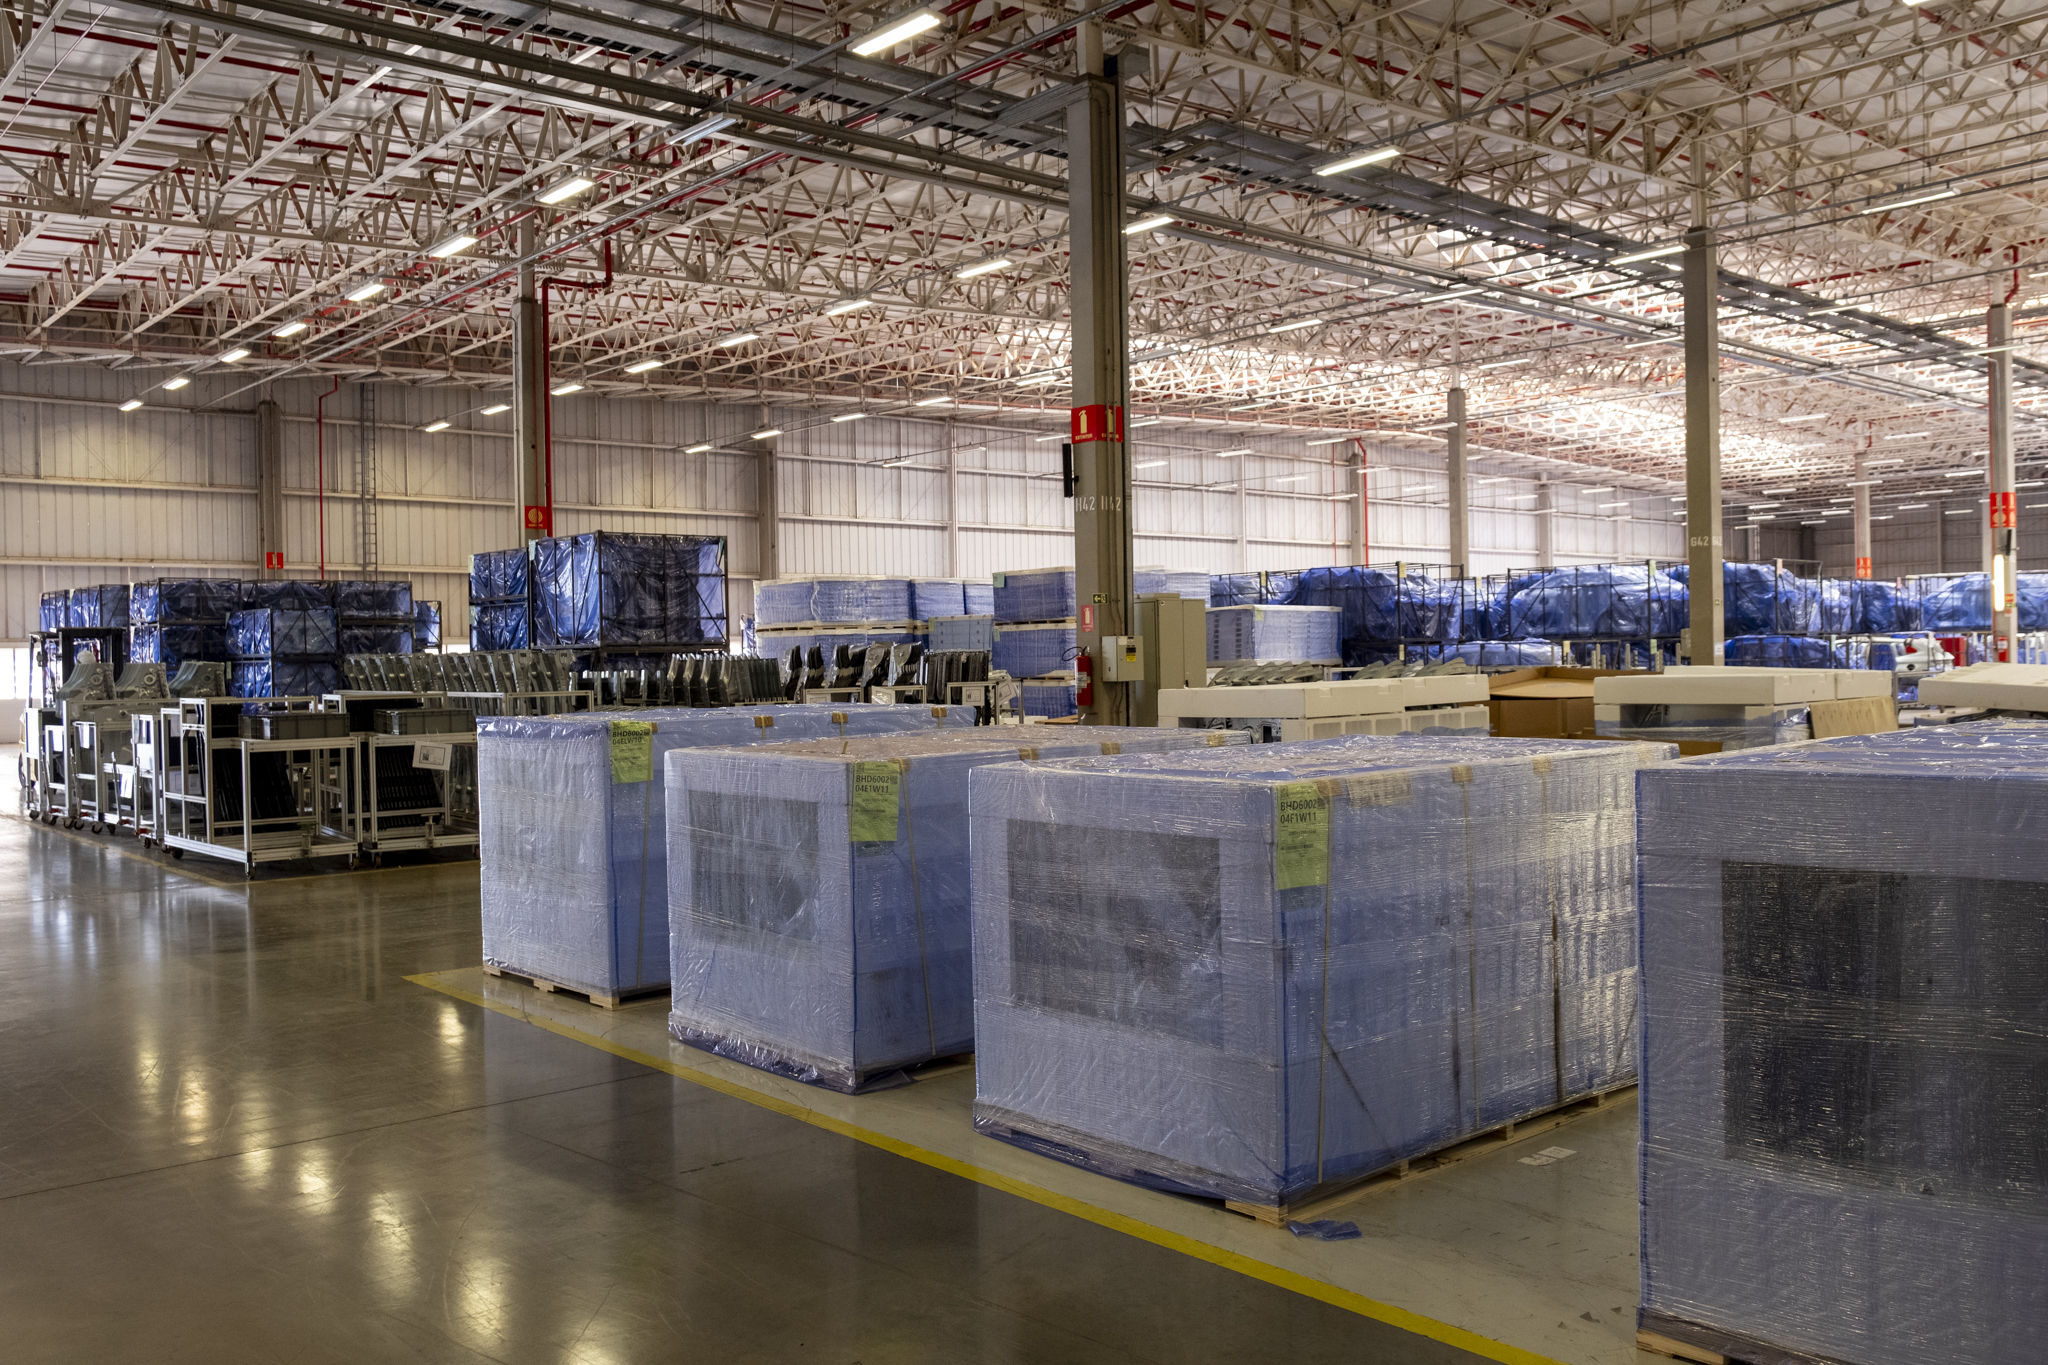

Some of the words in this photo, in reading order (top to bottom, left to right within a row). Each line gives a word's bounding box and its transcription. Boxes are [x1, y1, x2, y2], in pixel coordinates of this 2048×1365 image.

[1075, 496, 1095, 512] H42
[1690, 536, 1709, 547] G42
[612, 730, 644, 738] BHD6002
[855, 774, 890, 783] BHD6002
[855, 784, 889, 793] 04E1W11
[1280, 799, 1317, 811] BHD6002
